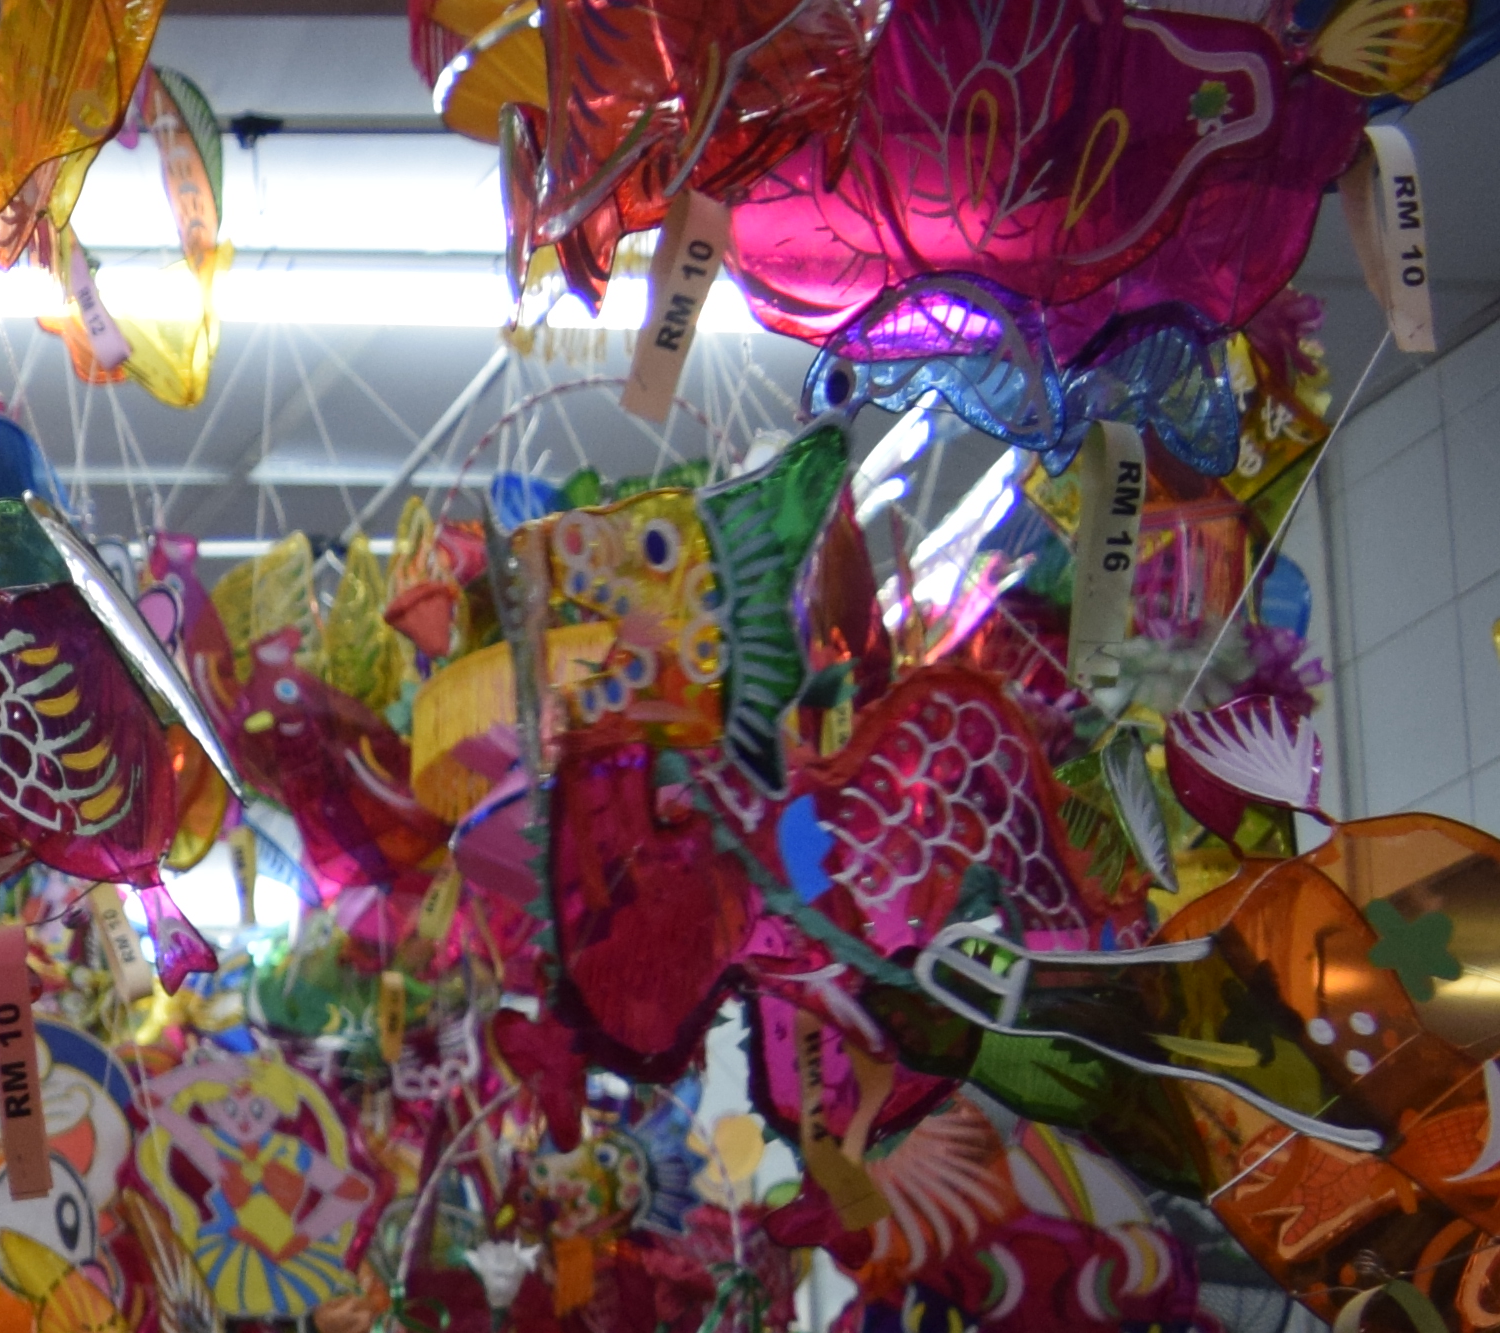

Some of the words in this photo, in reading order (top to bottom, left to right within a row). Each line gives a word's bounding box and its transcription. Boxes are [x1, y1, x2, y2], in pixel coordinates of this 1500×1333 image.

[1393, 173, 1420, 233] RM
[1402, 241, 1425, 289] 10
[76, 286, 91, 313] RM
[87, 313, 105, 337] 12
[657, 291, 699, 354] RM
[679, 238, 714, 284] 10
[1114, 460, 1142, 520] RM
[1102, 530, 1129, 575] 16
[114, 934, 135, 964] RM
[803, 1031, 822, 1087] RM
[2, 1056, 35, 1118] RM
[810, 1098, 831, 1143] 14
